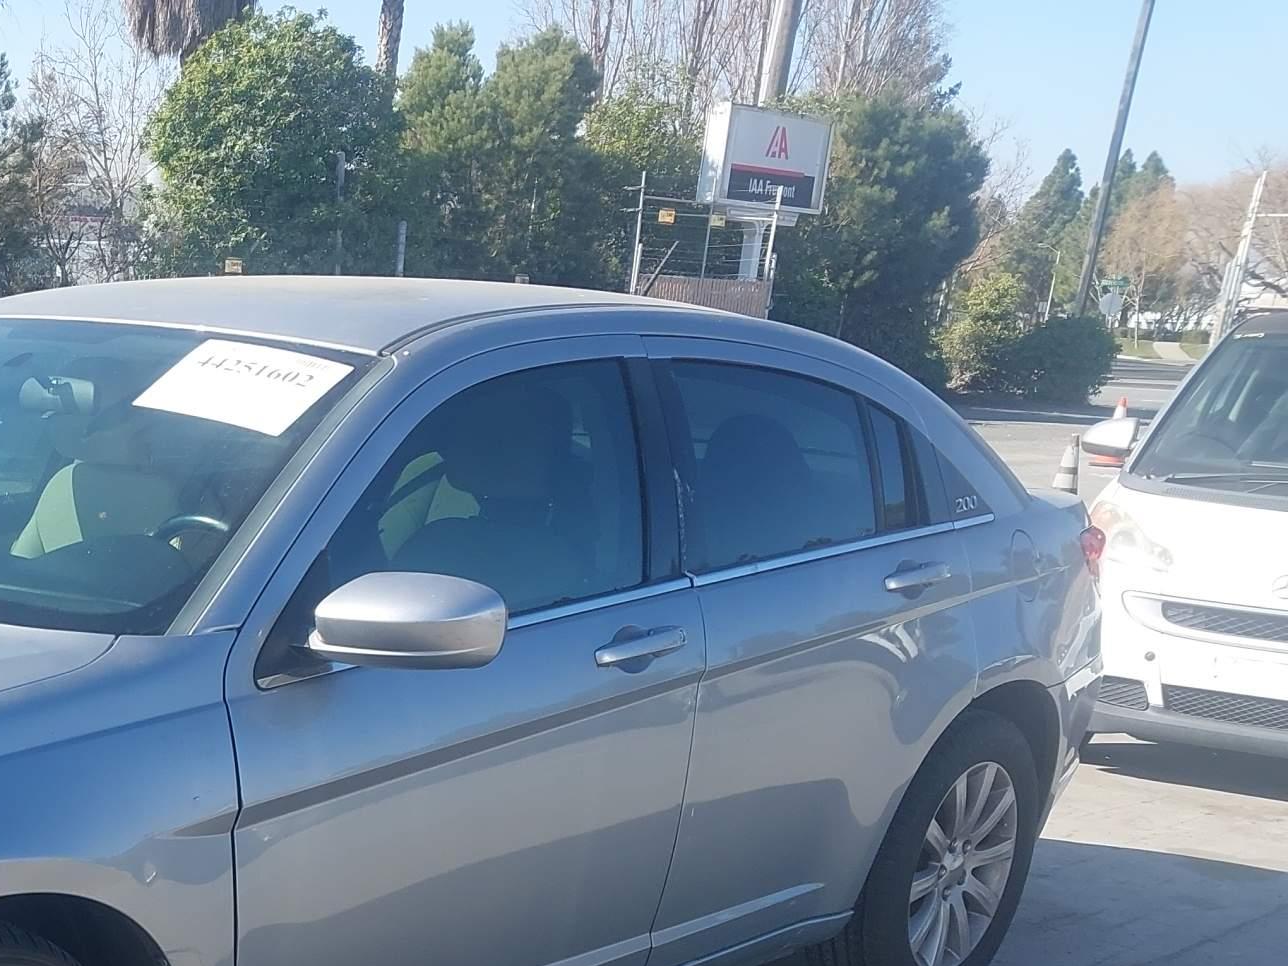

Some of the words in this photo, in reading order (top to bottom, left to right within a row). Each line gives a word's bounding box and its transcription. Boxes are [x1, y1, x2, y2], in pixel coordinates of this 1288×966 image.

[748, 178, 764, 195] IAA
[764, 180, 796, 198] Freont
[197, 355, 315, 387] 44251602
[955, 495, 977, 513] 200
